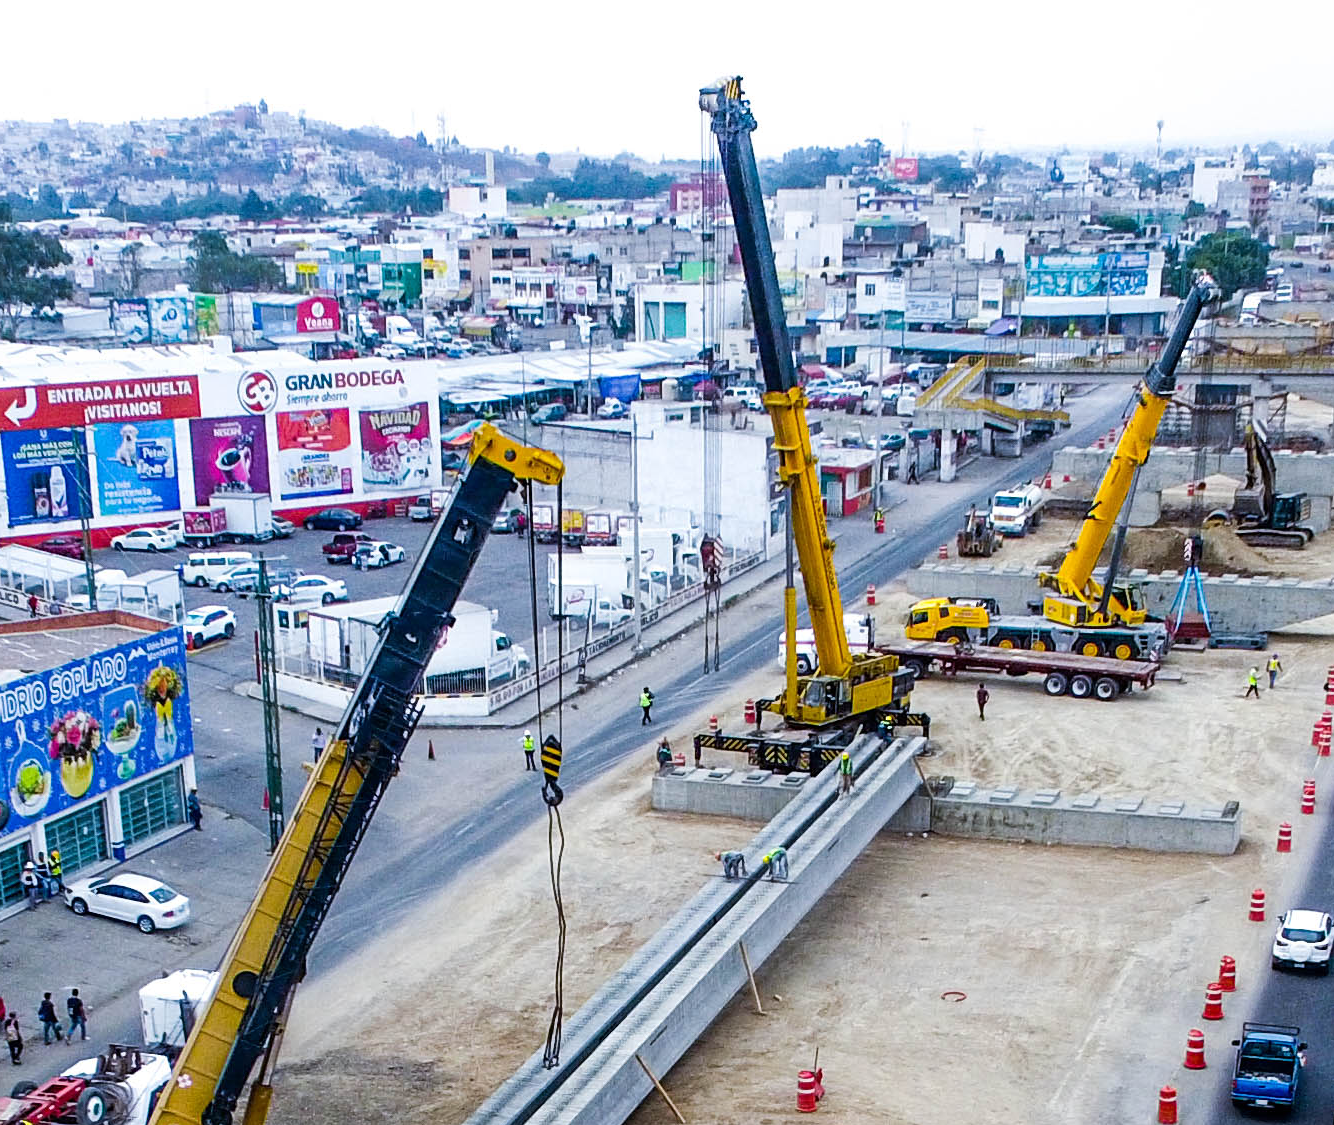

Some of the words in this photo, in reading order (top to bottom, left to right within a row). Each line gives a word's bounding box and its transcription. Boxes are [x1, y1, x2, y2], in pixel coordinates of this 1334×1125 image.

[47, 384, 113, 404] ENTRADA
[143, 380, 192, 397] VUELTA
[285, 372, 333, 392] GRAN
[335, 368, 404, 388] BODEGA
[84, 400, 162, 424] ¡VISITANOS!
[369, 410, 421, 430] NAVIDAD
[49, 653, 127, 704] SOPLADO
